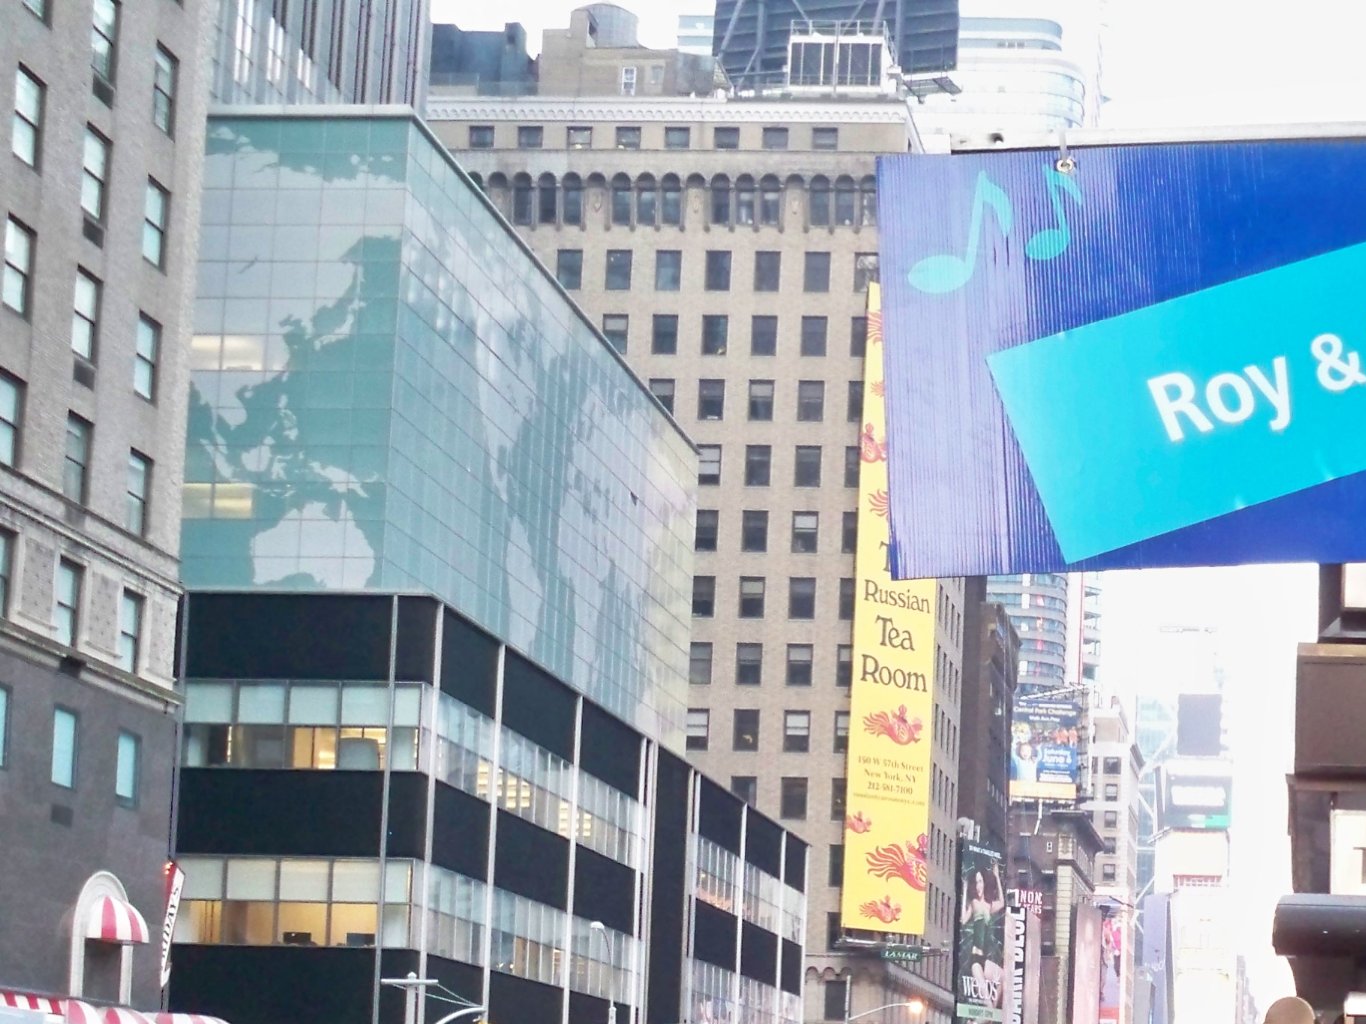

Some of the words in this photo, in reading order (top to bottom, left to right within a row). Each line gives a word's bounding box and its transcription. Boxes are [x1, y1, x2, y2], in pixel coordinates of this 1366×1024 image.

[1146, 355, 1295, 444] Roy
[864, 579, 930, 614] Russian
[875, 615, 915, 652] Tea
[860, 653, 928, 693] Room
